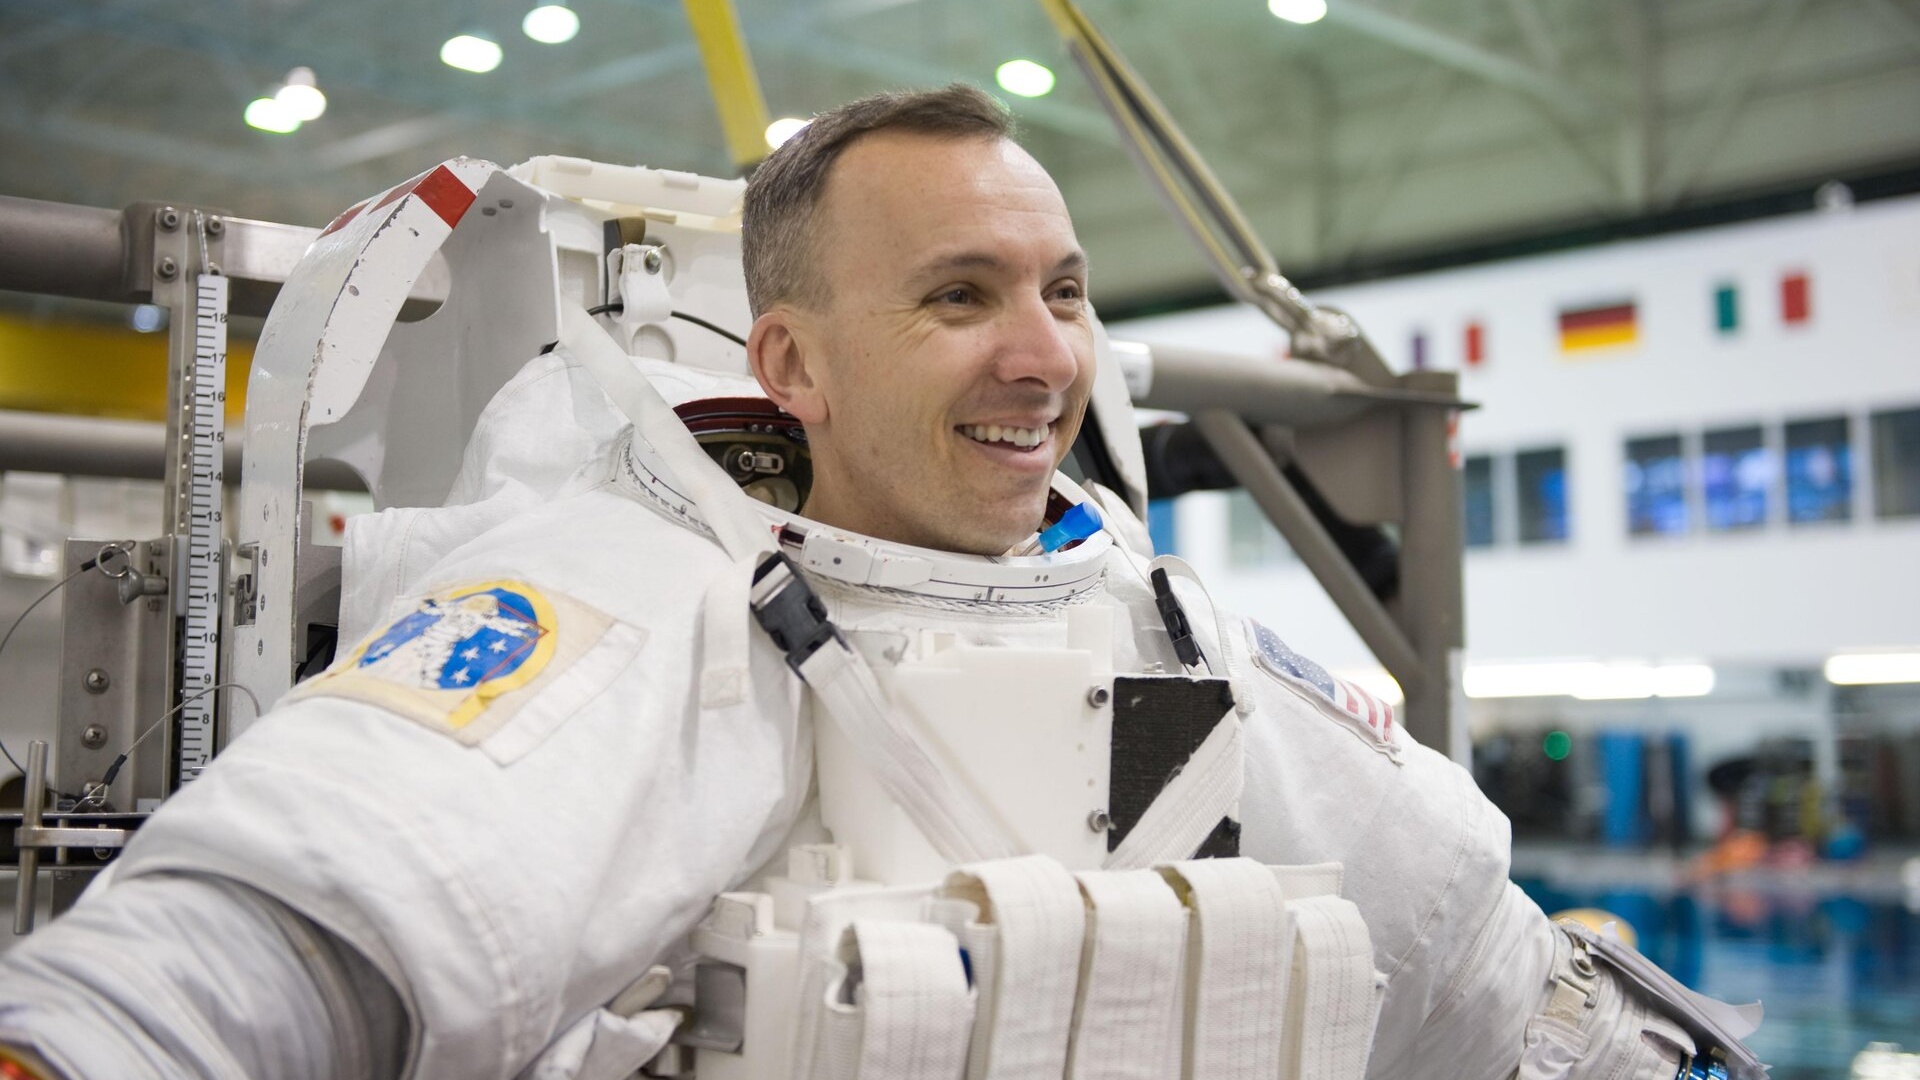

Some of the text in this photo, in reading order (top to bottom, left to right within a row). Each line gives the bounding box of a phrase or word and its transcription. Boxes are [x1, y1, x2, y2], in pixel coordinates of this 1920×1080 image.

[211, 312, 228, 324] 18
[211, 352, 227, 364] 17
[210, 391, 225, 402] 16
[208, 431, 224, 442] 15
[207, 471, 222, 482] 14
[206, 511, 221, 522] 13
[205, 551, 220, 563] 12
[204, 592, 217, 603] 11
[202, 632, 217, 643] 10
[204, 673, 211, 684] 9
[202, 713, 209, 724] 8
[201, 754, 208, 765] 7
